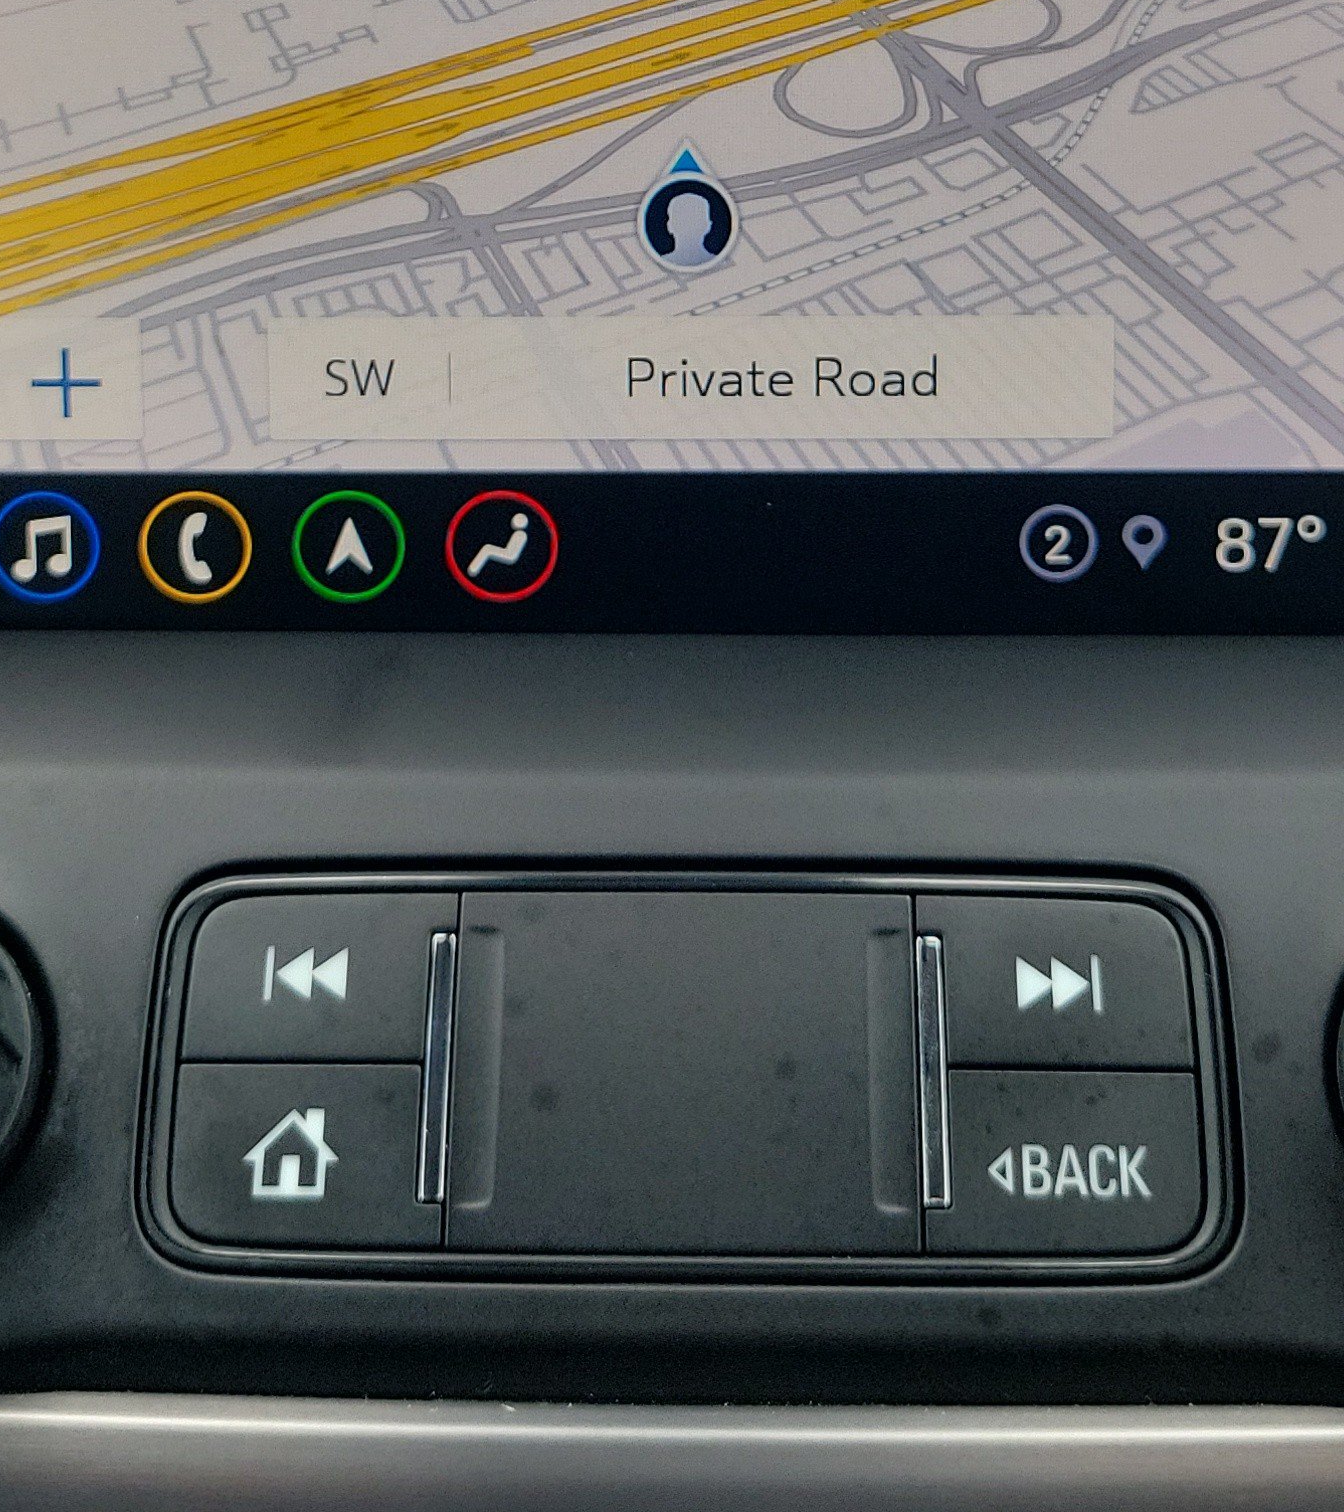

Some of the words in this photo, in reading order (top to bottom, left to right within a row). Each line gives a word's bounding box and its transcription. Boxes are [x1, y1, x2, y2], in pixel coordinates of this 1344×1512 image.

[324, 359, 396, 397] SW
[624, 356, 795, 398] Private
[814, 354, 939, 399] Road
[1042, 525, 1076, 565] 2
[1214, 514, 1328, 574] 87°
[1020, 1142, 1154, 1200] BACK
